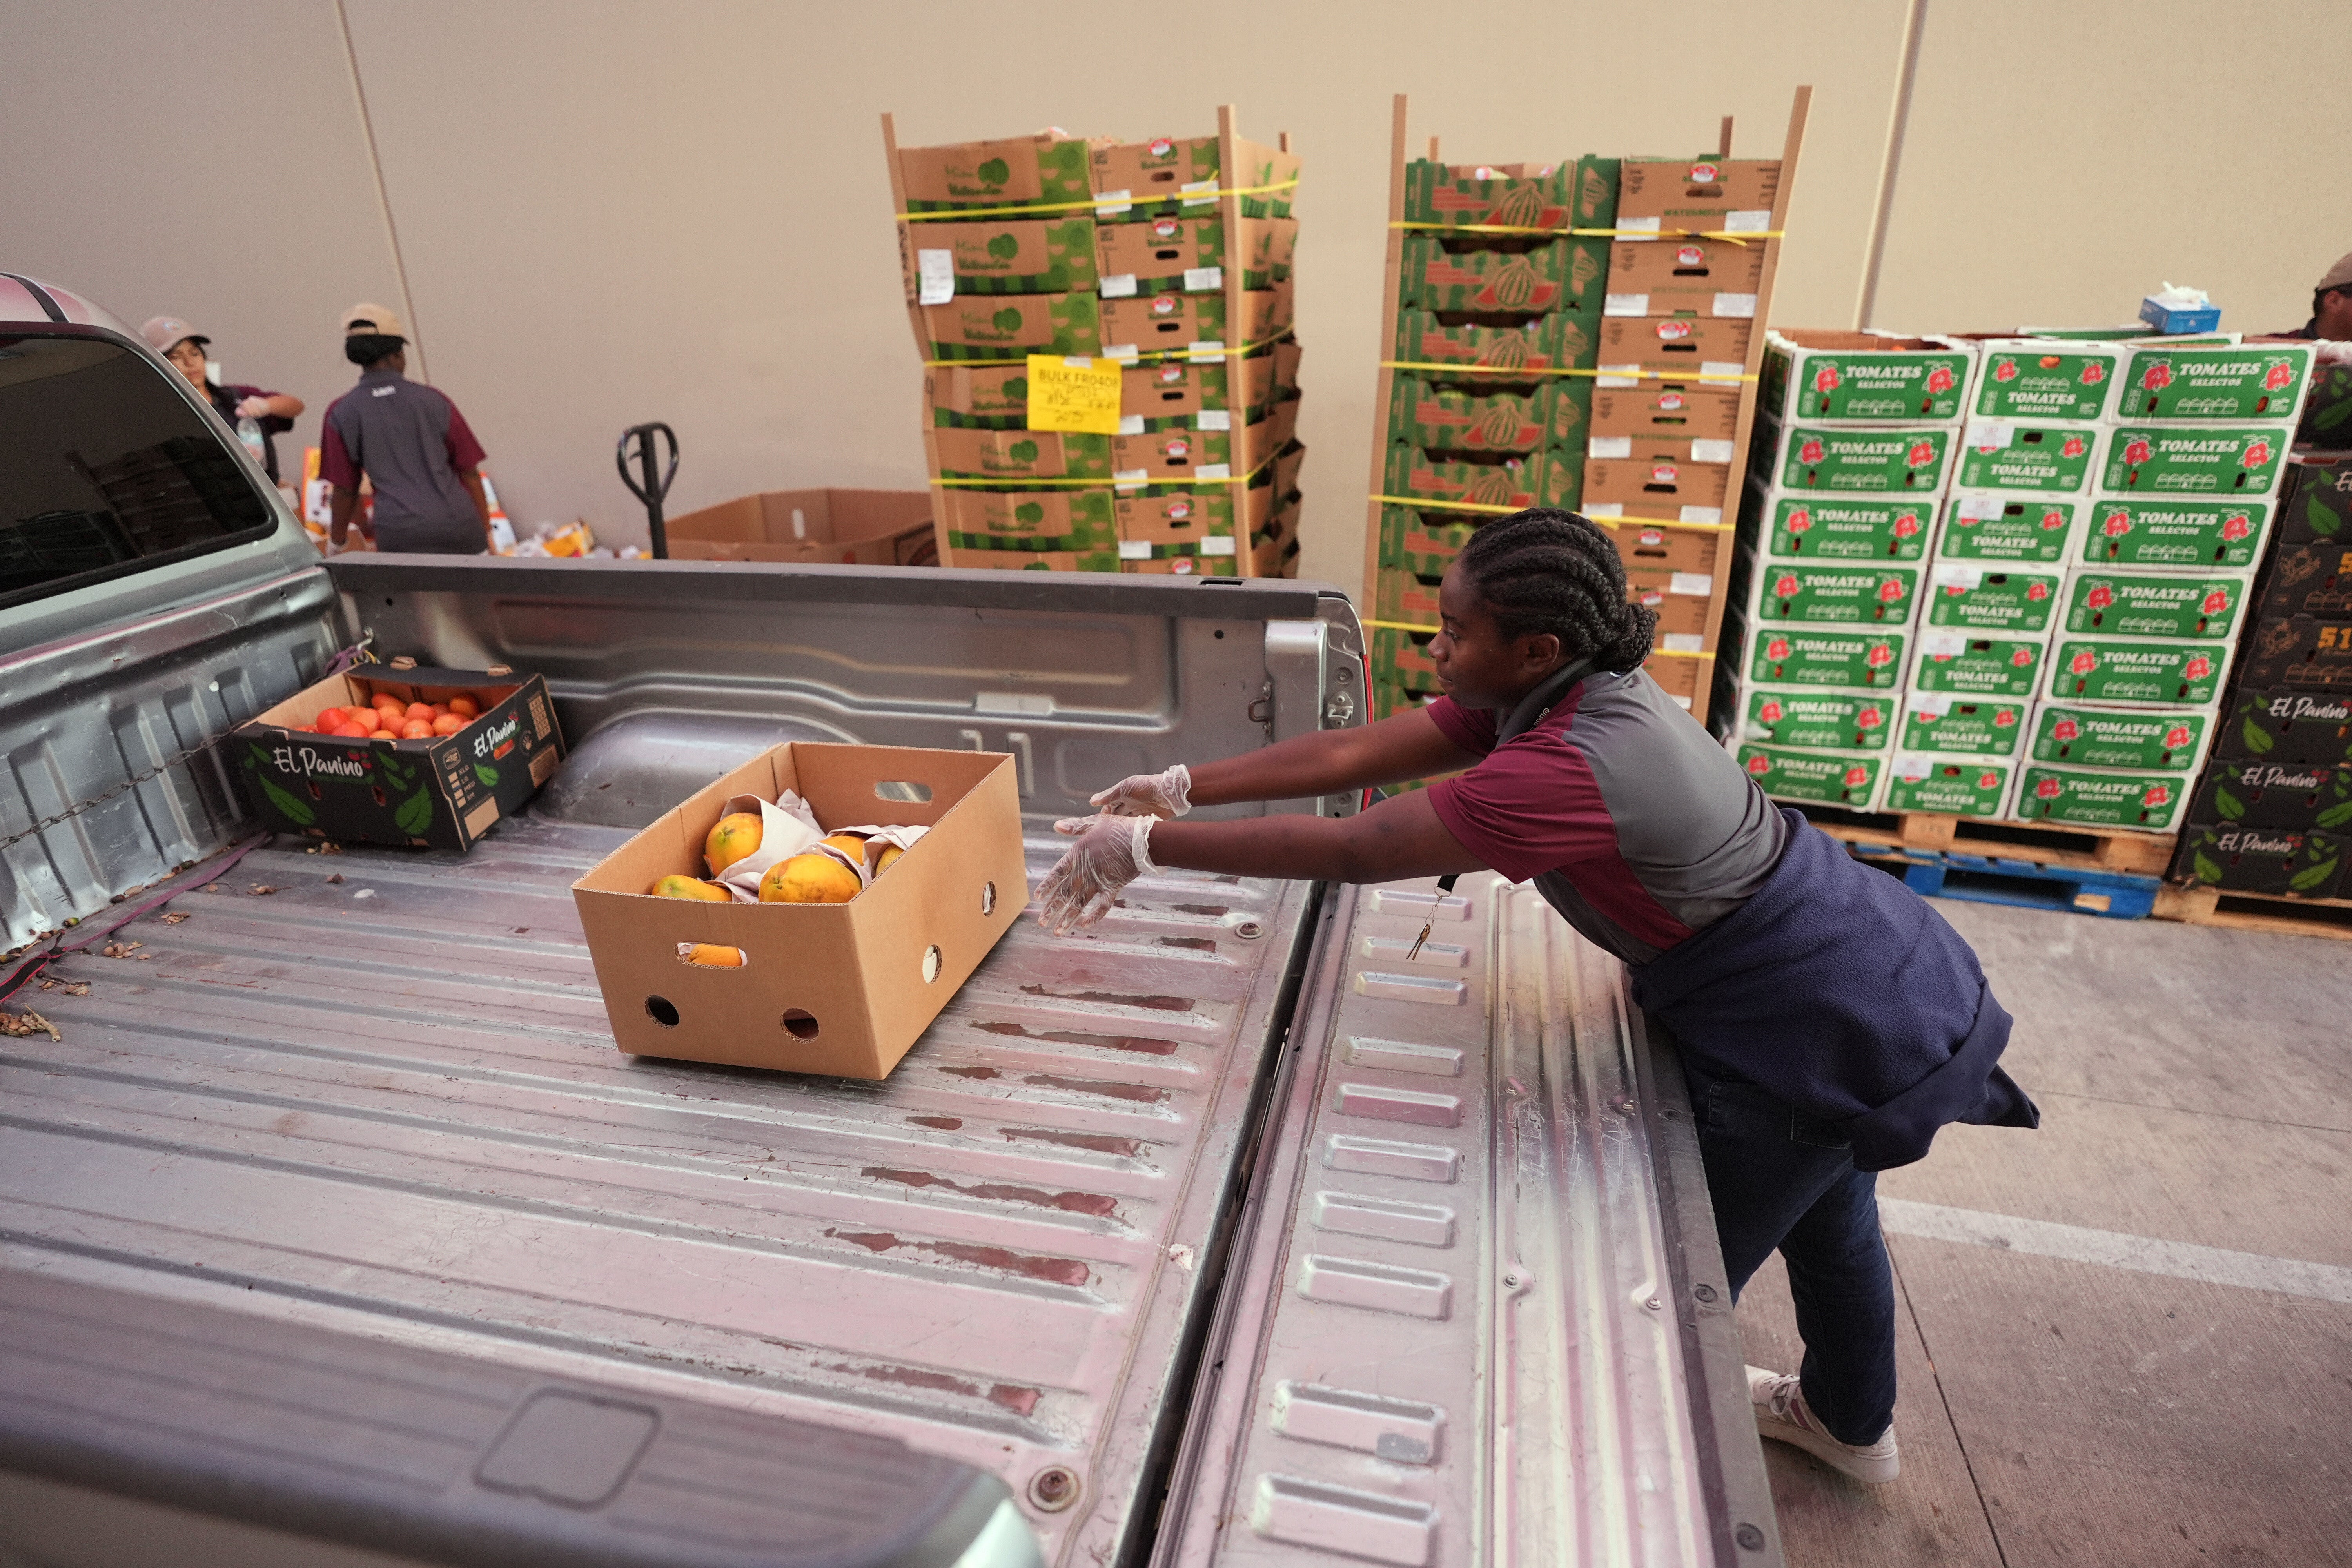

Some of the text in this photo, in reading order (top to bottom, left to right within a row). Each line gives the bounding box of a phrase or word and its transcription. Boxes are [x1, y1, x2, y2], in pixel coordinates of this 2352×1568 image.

[1846, 366, 1922, 378] TOMATES
[2180, 363, 2261, 376] TOMATES
[2190, 378, 2242, 387] SELECTOS
[2009, 391, 2076, 405] TOMATES
[1831, 442, 1904, 454] TOMATES
[2160, 441, 2239, 452] TOMATES
[1991, 464, 2057, 477] TOMATES
[1818, 510, 1888, 522] TOMATES
[2139, 512, 2218, 525] TOMATES
[2148, 526, 2200, 535] SELECTOS
[1973, 536, 2037, 548] TOMATES
[1805, 575, 1874, 587] TOMATES
[2121, 587, 2198, 601] TOMATES
[1960, 605, 2022, 617] TOMATES
[1796, 640, 1863, 652] TOMATES
[2103, 652, 2180, 666] TOMATES
[1947, 671, 2008, 683] TOMATES
[1789, 702, 1852, 714] TOMATES
[2269, 697, 2348, 719] El Panino
[2087, 722, 2161, 735] TOMATES
[474, 720, 516, 757] El Panino
[1931, 732, 1991, 744] TOMATES
[273, 746, 363, 777] El Panino
[1776, 759, 1840, 774] TOMATES
[2240, 766, 2317, 788] El Panino
[2069, 781, 2140, 794] TOMATES
[1916, 792, 1975, 804] TOMATES
[2217, 832, 2292, 853] El Panino
